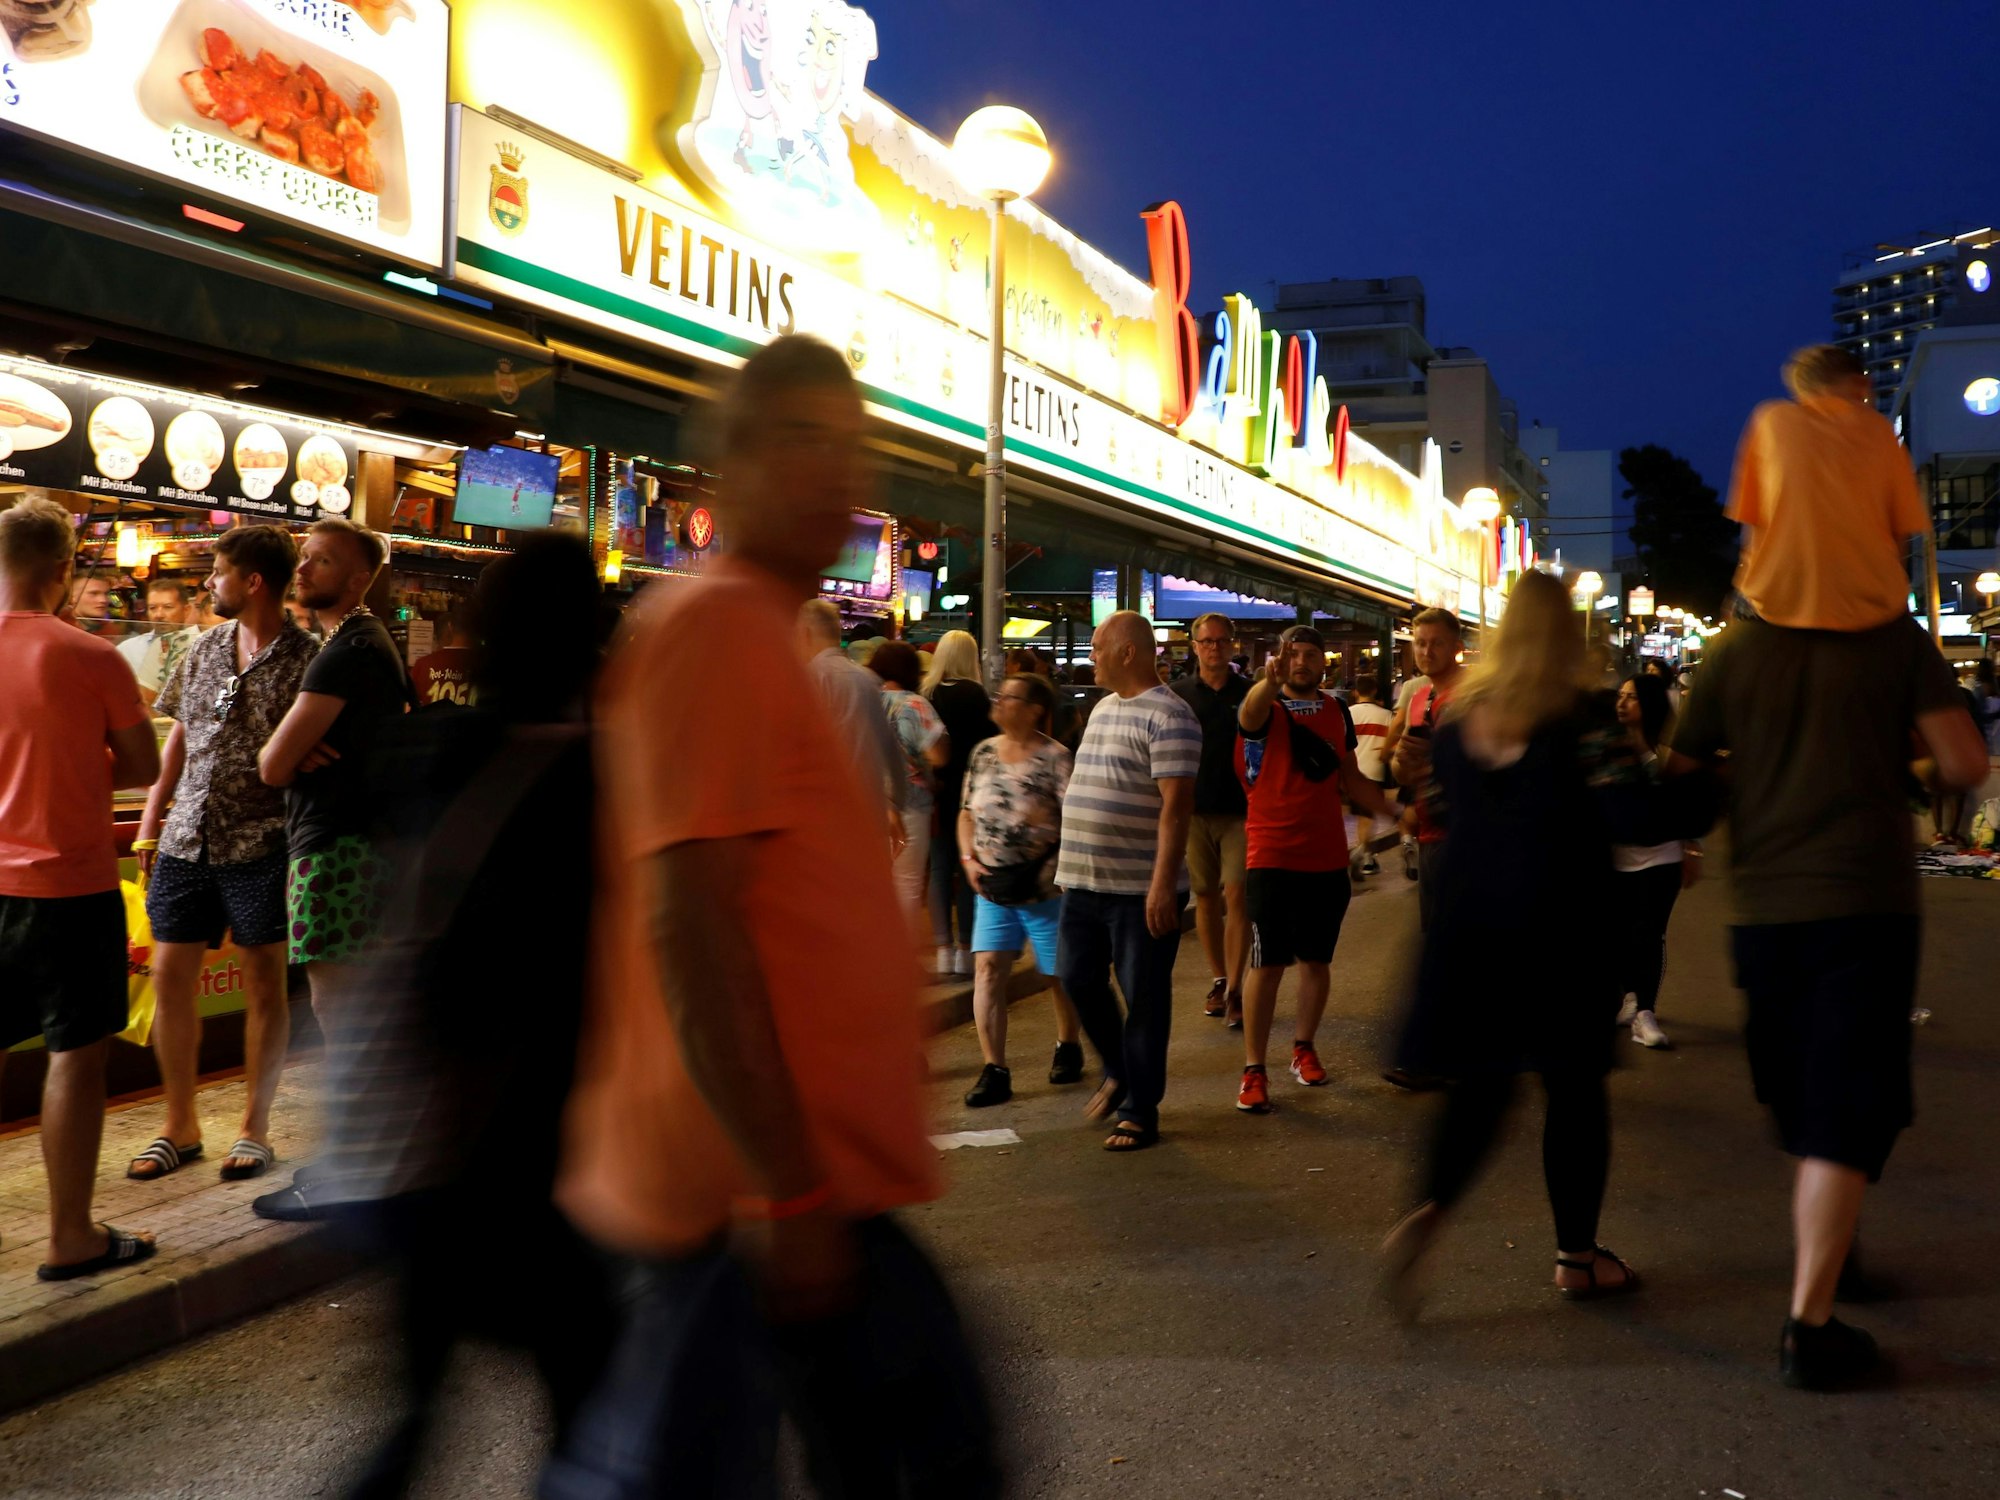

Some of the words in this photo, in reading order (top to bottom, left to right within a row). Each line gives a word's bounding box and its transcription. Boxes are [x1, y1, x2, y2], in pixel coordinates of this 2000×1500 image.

[612, 193, 799, 338] VELTINS
[81, 475, 100, 488] Mit
[100, 477, 147, 495] Brötchen
[158, 486, 176, 499] Mit
[177, 488, 218, 504] Brötchen
[227, 496, 241, 507] Mit
